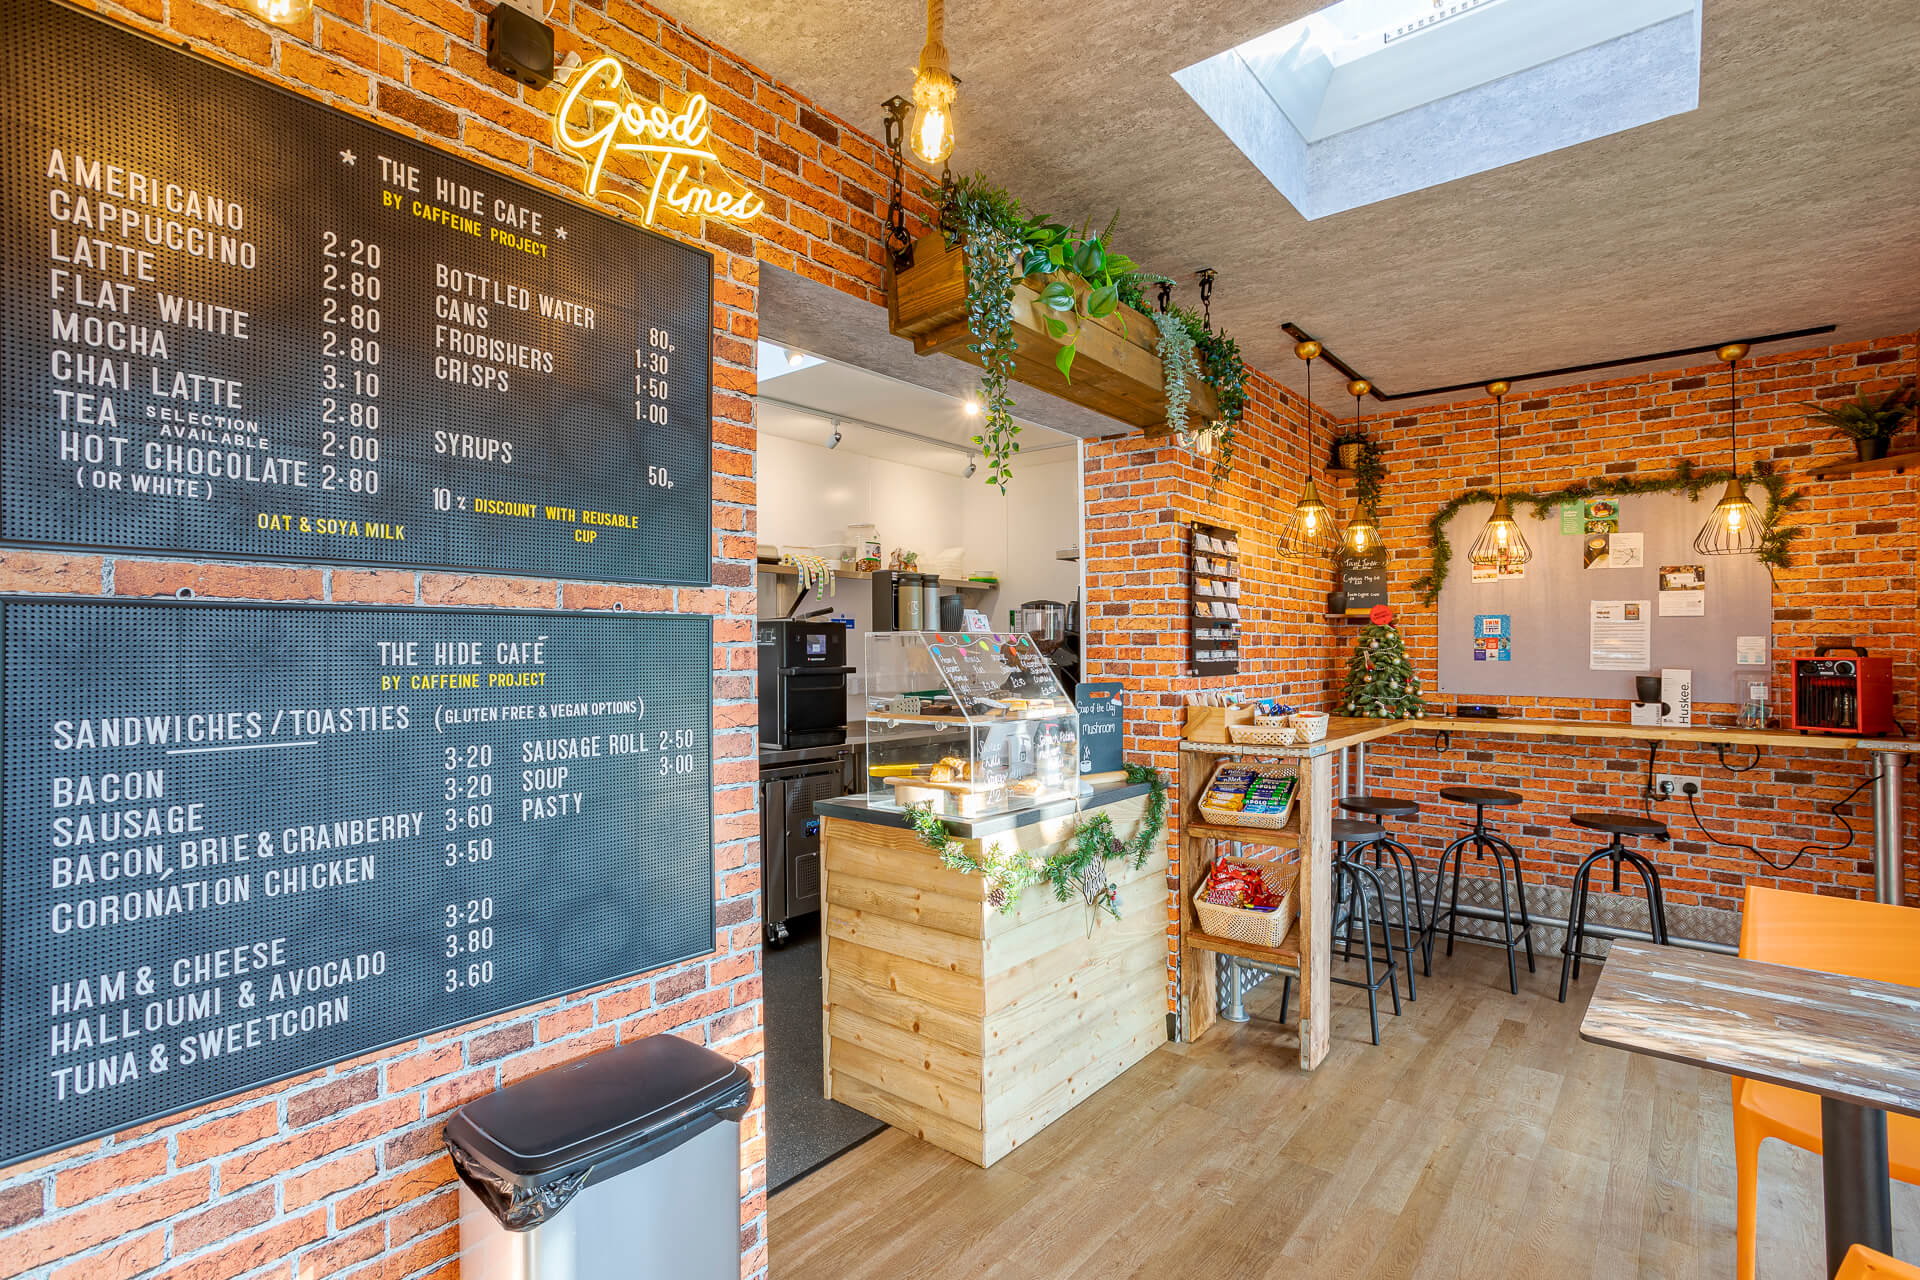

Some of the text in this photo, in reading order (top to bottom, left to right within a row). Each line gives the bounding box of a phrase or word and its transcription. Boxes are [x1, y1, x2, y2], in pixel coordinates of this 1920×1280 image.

[559, 57, 708, 195] Good
[47, 149, 380, 268] AMERICANO 2.20
[378, 156, 542, 235] THE HIDE CAFE
[616, 143, 764, 225] Times
[49, 189, 380, 300] CAPPUCCINO 2.80
[384, 191, 547, 257] BY CAFFEINE PROJECT
[51, 229, 379, 332] LATTE 2.80
[437, 264, 529, 310] BOTTLED
[539, 294, 594, 329] WATER
[51, 269, 379, 365] FLAT WHITE 2.80
[436, 295, 667, 374] CANS 1.30
[53, 309, 378, 397] MOCHA 3.10
[436, 326, 667, 400] FROBISHERS 1.50
[52, 350, 378, 429] CHAI LATTE 2.80
[147, 406, 257, 436] SELECTION
[436, 356, 667, 425] CRISPS 1.00
[53, 390, 378, 461] TEA 2.00
[160, 421, 268, 449] AVAILABLE
[435, 431, 512, 463] SYRUPS
[61, 431, 378, 494] HOT CHOCOLATE 2.80
[259, 513, 404, 540] OAT & SOYA MILK
[475, 499, 536, 518] DISCOUNT
[546, 507, 575, 522] WITH
[583, 511, 638, 528] REUSABLE
[575, 530, 596, 543] CUP
[377, 642, 418, 665] THE
[436, 642, 482, 665] HIDE
[382, 673, 545, 690] BY CAFFEINE PROJECT
[435, 705, 497, 733] (GLUTEN
[503, 706, 534, 720] FREE
[539, 705, 547, 718] &
[551, 703, 587, 717] VEGAN
[592, 696, 644, 720] OPTIONS)
[1077, 700, 1116, 716] Soup of the Day
[54, 745, 491, 807] BACON 3.20
[523, 736, 600, 762] SAUSAGE
[610, 733, 648, 755] ROLL
[523, 767, 568, 791] SOUP
[53, 774, 491, 846] SAUSAGE 3.20
[181, 834, 249, 869] BRIE
[258, 832, 273, 857] &
[283, 812, 423, 854] CRANBERRY
[446, 804, 492, 831] 3.60
[523, 792, 582, 821] PASTY
[52, 838, 492, 933] CORONATION CHICKEN 3.50
[52, 898, 492, 1016] HAM & CHEESE 3.20
[52, 927, 492, 1056] HALLOUMI & AVOCADO 3.80
[51, 961, 492, 1100] TUNA & SWEETCORN 3.60
